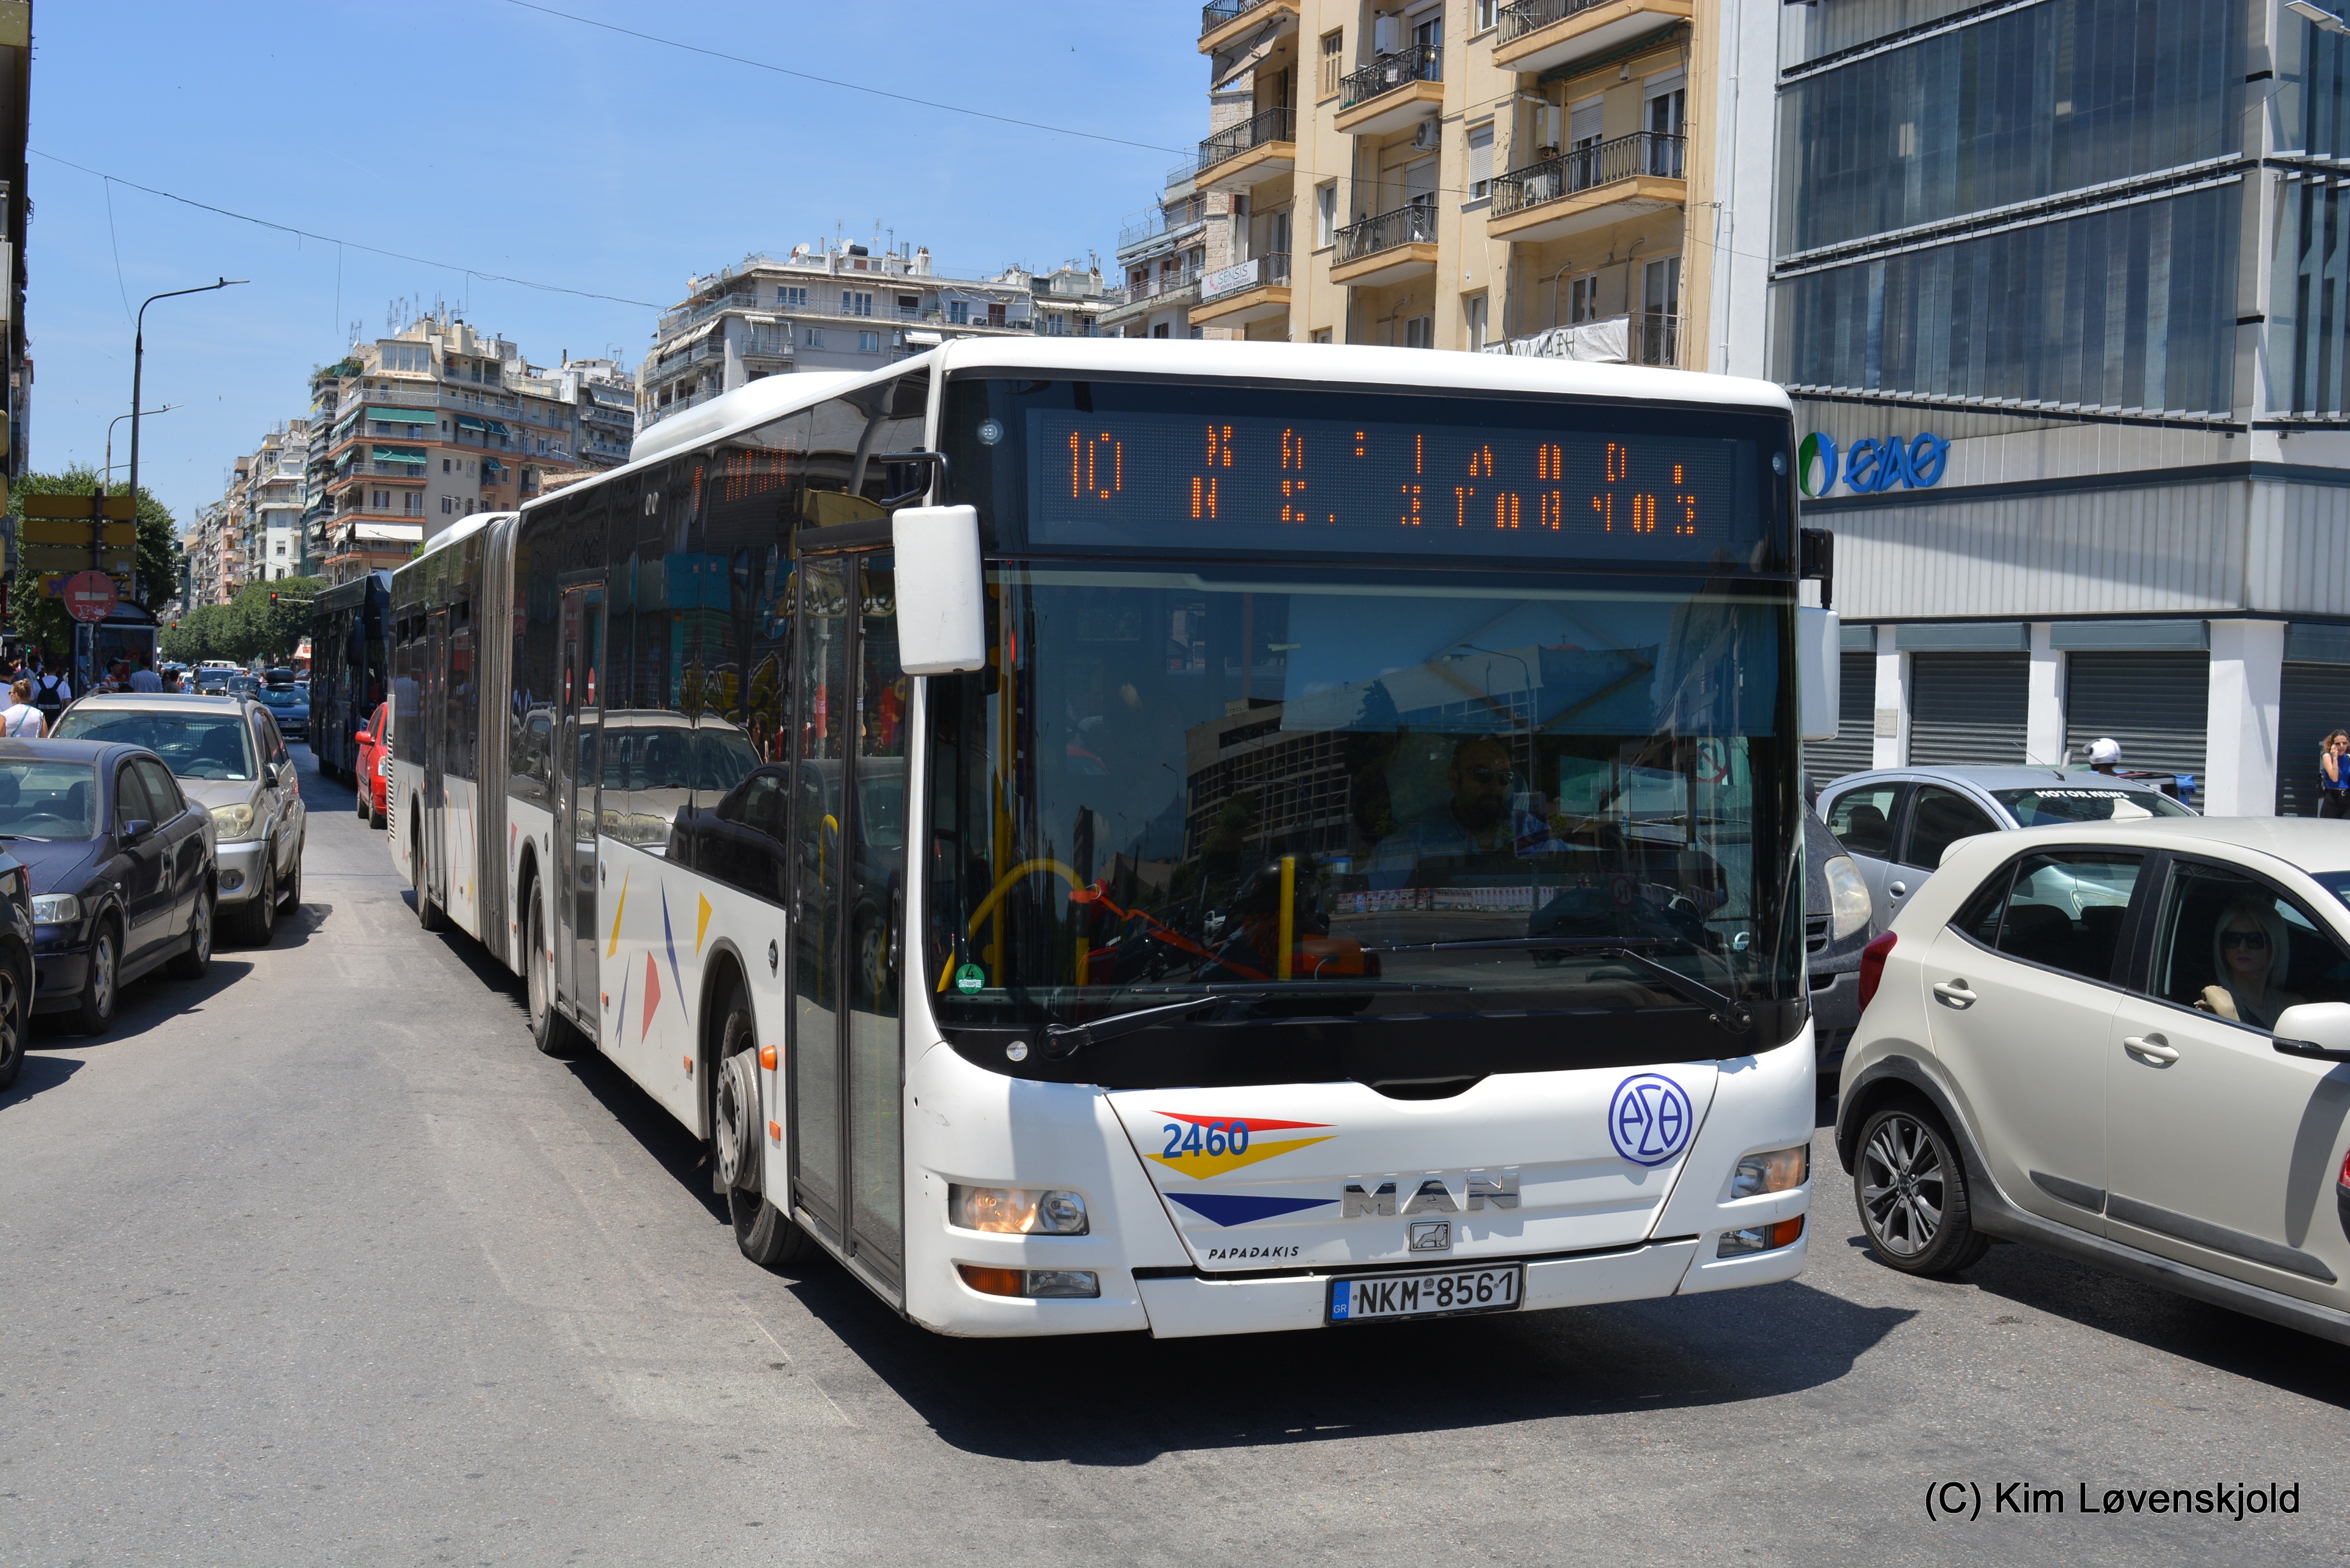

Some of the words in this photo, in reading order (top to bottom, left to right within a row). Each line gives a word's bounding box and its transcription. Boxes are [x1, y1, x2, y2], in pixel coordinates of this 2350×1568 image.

[1218, 264, 1247, 285] SENSIS
[964, 965, 975, 979] 4
[1163, 1121, 1249, 1159] 2460
[1341, 1173, 1520, 1218] MAN
[1208, 1246, 1300, 1260] PAPADAKIS
[1334, 1304, 1347, 1314] GR
